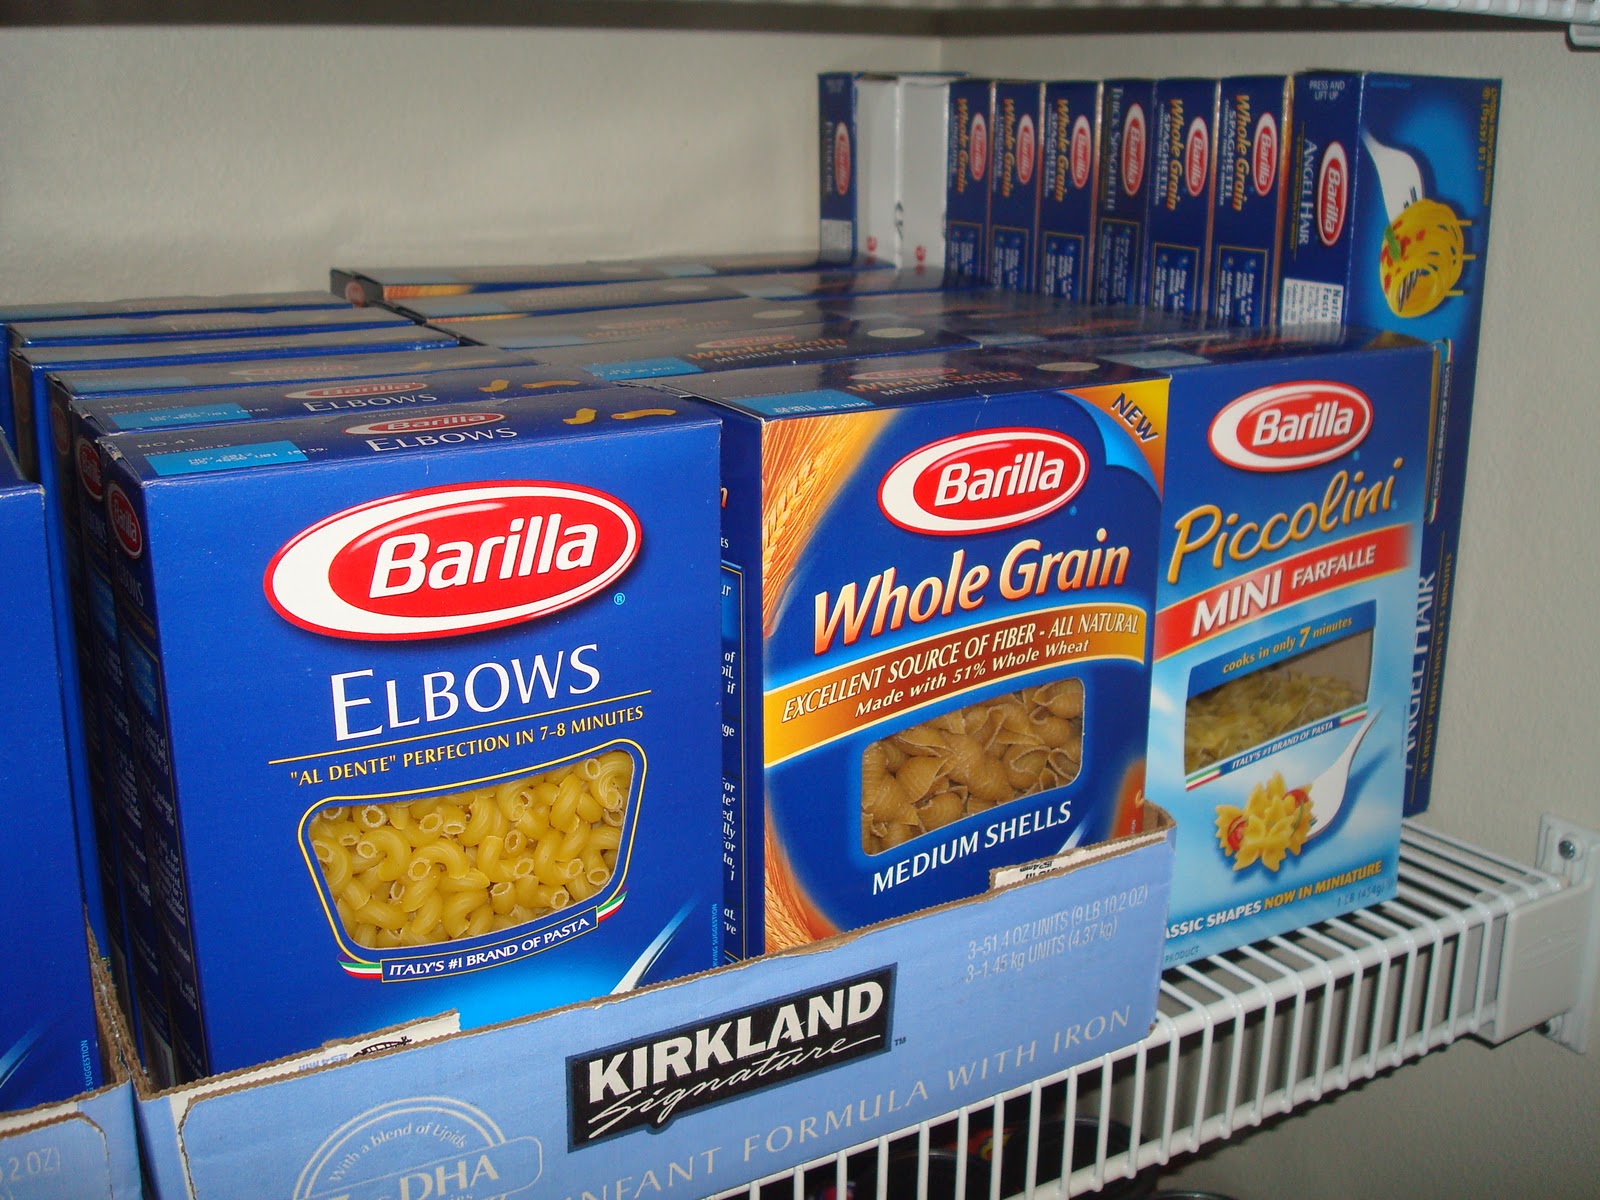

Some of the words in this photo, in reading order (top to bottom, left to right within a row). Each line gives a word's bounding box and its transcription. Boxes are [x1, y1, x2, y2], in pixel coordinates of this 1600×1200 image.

[1309, 80, 1328, 90] PRESS
[1330, 80, 1346, 90] AND
[1314, 90, 1328, 100] LIFT
[1329, 91, 1339, 100] UP
[956, 98, 968, 149] Whole
[1003, 98, 1015, 150] Whole
[1056, 98, 1069, 152] Whole
[1170, 98, 1184, 156] Whole
[1236, 94, 1251, 155] Whole
[956, 150, 968, 193] Grain
[1002, 152, 1014, 198] Grain
[1055, 154, 1068, 202] Grain
[1160, 113, 1170, 197] SPAGHETTI
[1190, 136, 1203, 188] Barilla
[1225, 110, 1237, 196] SPAGHETTI
[1259, 134, 1272, 186] Barilla
[1302, 138, 1318, 197] ANGEL
[1166, 159, 1184, 211] Grain
[1232, 158, 1251, 211] Grain
[1323, 167, 1342, 234] Barilla
[1298, 200, 1315, 246] HAIR
[1322, 288, 1331, 318] Facts
[302, 393, 438, 413] ELBOWS
[387, 414, 487, 431] Barilla
[1110, 392, 1158, 443] NEW
[1252, 400, 1355, 447] Barilla
[364, 426, 518, 452] ELBOWS
[934, 450, 1066, 508] Barilla
[110, 496, 138, 543] Barilla
[1166, 456, 1404, 584] Piccolini
[368, 514, 598, 600] Barilla
[814, 548, 990, 656] Whole
[1000, 528, 1131, 600] Grain
[1191, 568, 1283, 638] MINI
[1291, 544, 1377, 590] FARFALLE
[1412, 571, 1437, 655] HAIR
[724, 650, 736, 662] of
[781, 665, 886, 723] EXCELLENT
[887, 641, 960, 684] SOURCE
[964, 634, 990, 658] OF
[992, 624, 1036, 654] FIBER
[1048, 615, 1075, 638] ALL
[1077, 610, 1140, 635] NATURAL
[1222, 653, 1256, 675] cooks
[1258, 645, 1270, 660] in
[1272, 636, 1296, 658] only
[1299, 626, 1310, 650] 7
[1312, 616, 1354, 640] minutes
[330, 643, 601, 741] ELBOWS
[727, 680, 736, 696] if
[855, 690, 903, 718] Made
[910, 672, 947, 698] with
[952, 662, 986, 684] 51%
[992, 649, 1039, 677] Whole
[1044, 638, 1090, 662] Wheat
[290, 768, 324, 787] "AL
[328, 754, 398, 782] DENTE"
[402, 734, 511, 768] PERFECTION
[515, 729, 534, 745] IN
[540, 722, 566, 741] 7-8
[570, 706, 645, 735] MINUTES
[1231, 752, 1261, 770] ITALY'S
[1272, 733, 1299, 755] BRAND
[1299, 730, 1311, 743] OF
[1311, 720, 1334, 739] PASTA
[872, 832, 980, 896] MEDIUM
[984, 800, 1072, 850] SHELLS
[968, 930, 1009, 960] 3-51.4
[1012, 922, 1030, 946] OZ
[1032, 911, 1069, 939] UNITS
[1072, 906, 1083, 927] (9
[1086, 900, 1100, 922] LB
[1104, 892, 1126, 915] 10.2
[1128, 884, 1149, 908] OZ)
[1206, 900, 1262, 928] SHAPES
[1264, 890, 1296, 910] NOW
[1298, 884, 1313, 900] IN
[1314, 860, 1382, 894] MINIATURE
[388, 961, 446, 978] ITALY'S
[466, 944, 518, 968] BRAND
[520, 936, 542, 952] OF
[544, 917, 590, 944] PASTA
[966, 952, 1008, 984] 3-1.45
[1010, 950, 1025, 972] kg
[1028, 934, 1066, 964] UNITS
[1068, 924, 1098, 950] (4.37
[1100, 917, 1118, 941] kg)
[1165, 946, 1200, 963] PRODUCT
[80, 1039, 94, 1086] SUGGESTION
[588, 981, 884, 1102] KIRKLAND
[565, 1146, 722, 1200] NFANT
[742, 1080, 928, 1163] FORMULA
[946, 1044, 1036, 1093] WITH
[1052, 1004, 1132, 1057] IRON
[589, 1034, 881, 1138] Signature
[328, 1150, 361, 1182] With
[361, 1144, 371, 1154] a
[370, 1122, 412, 1148] blend
[415, 1122, 434, 1135] of
[432, 1124, 468, 1150] Lipids
[399, 1154, 500, 1200] DHA
